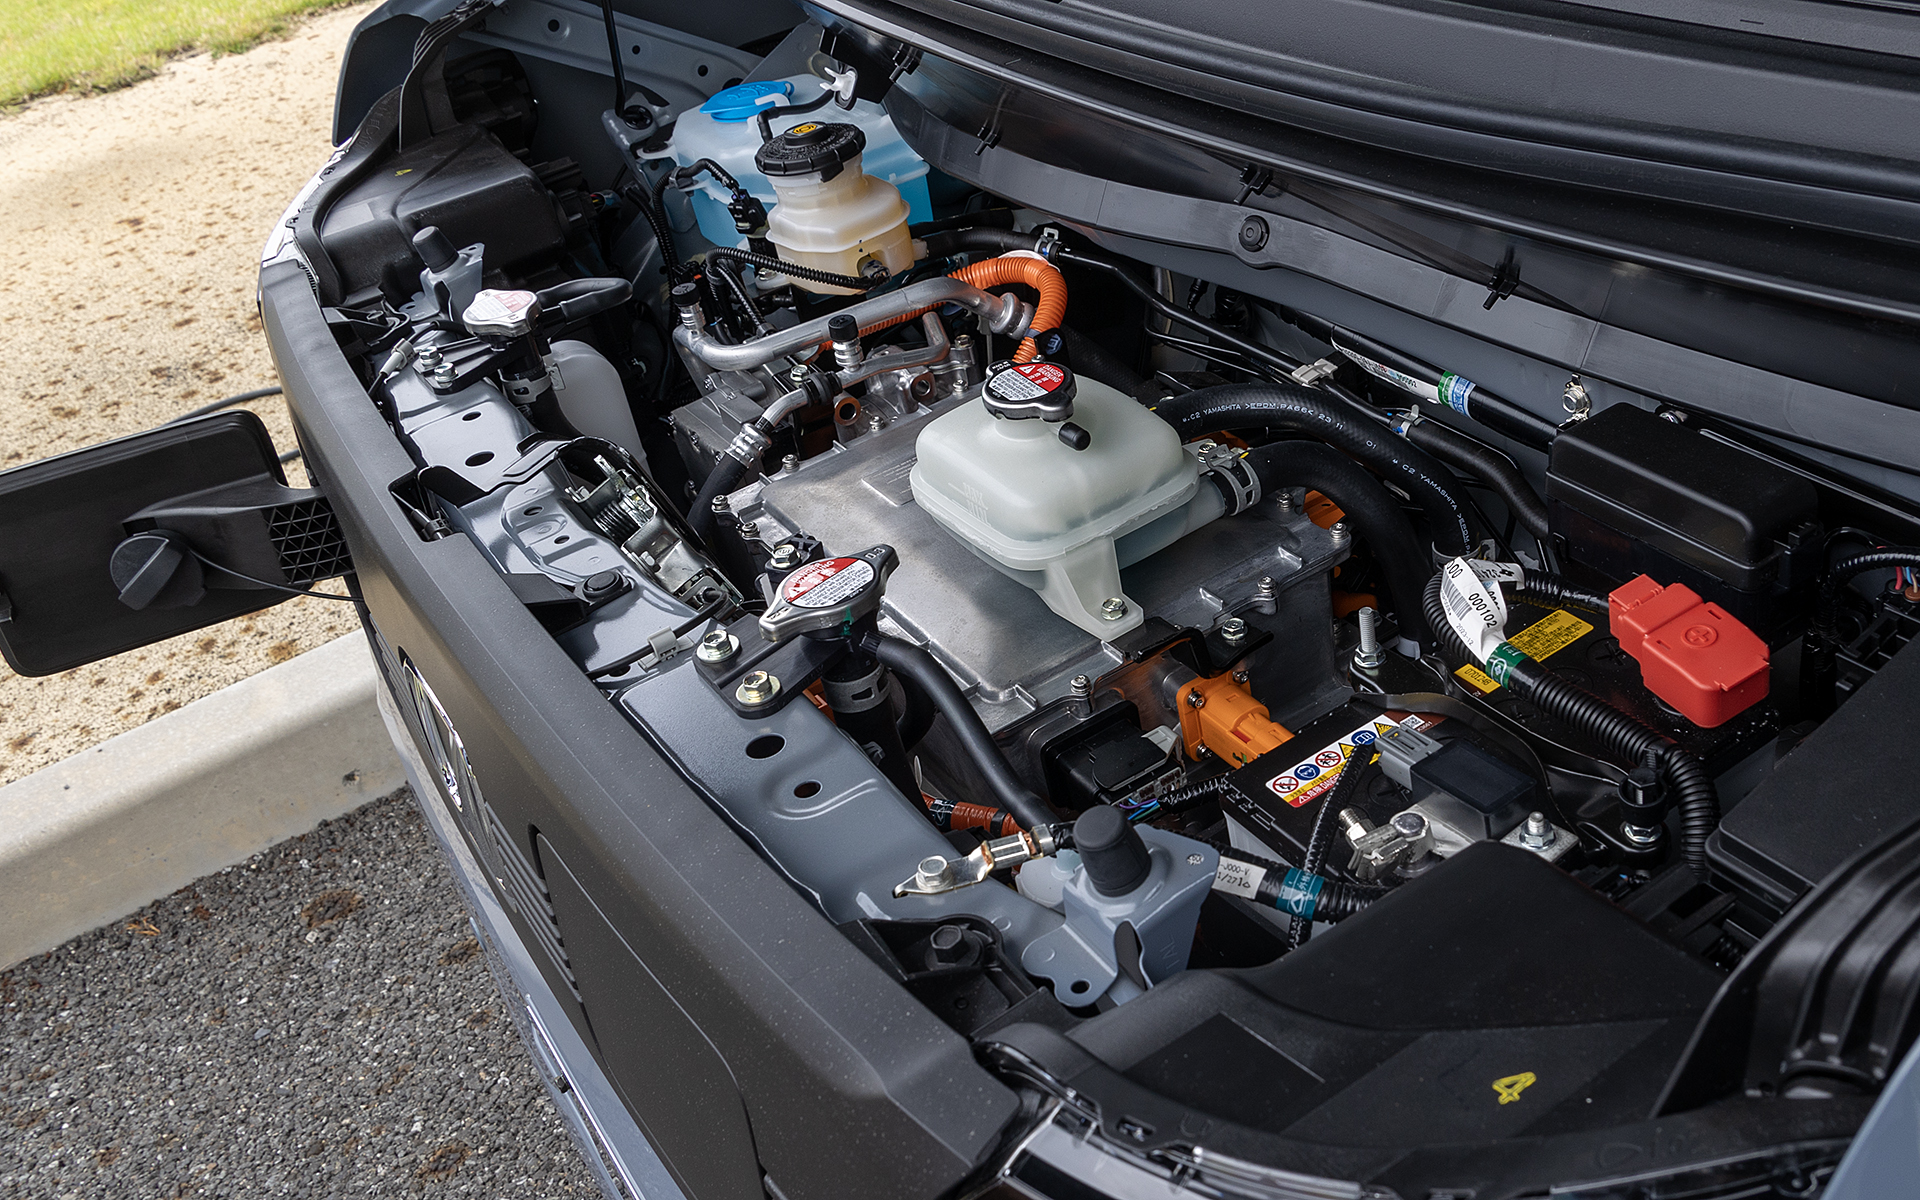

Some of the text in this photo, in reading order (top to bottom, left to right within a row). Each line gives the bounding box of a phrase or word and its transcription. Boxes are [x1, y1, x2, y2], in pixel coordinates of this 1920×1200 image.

[1203, 403, 1242, 416] YAMASHITA
[1420, 473, 1458, 511] YAMASHITA
[1468, 592, 1498, 629] 000102
[1455, 622, 1475, 647] 2023-12
[1492, 1072, 1537, 1105] 4
